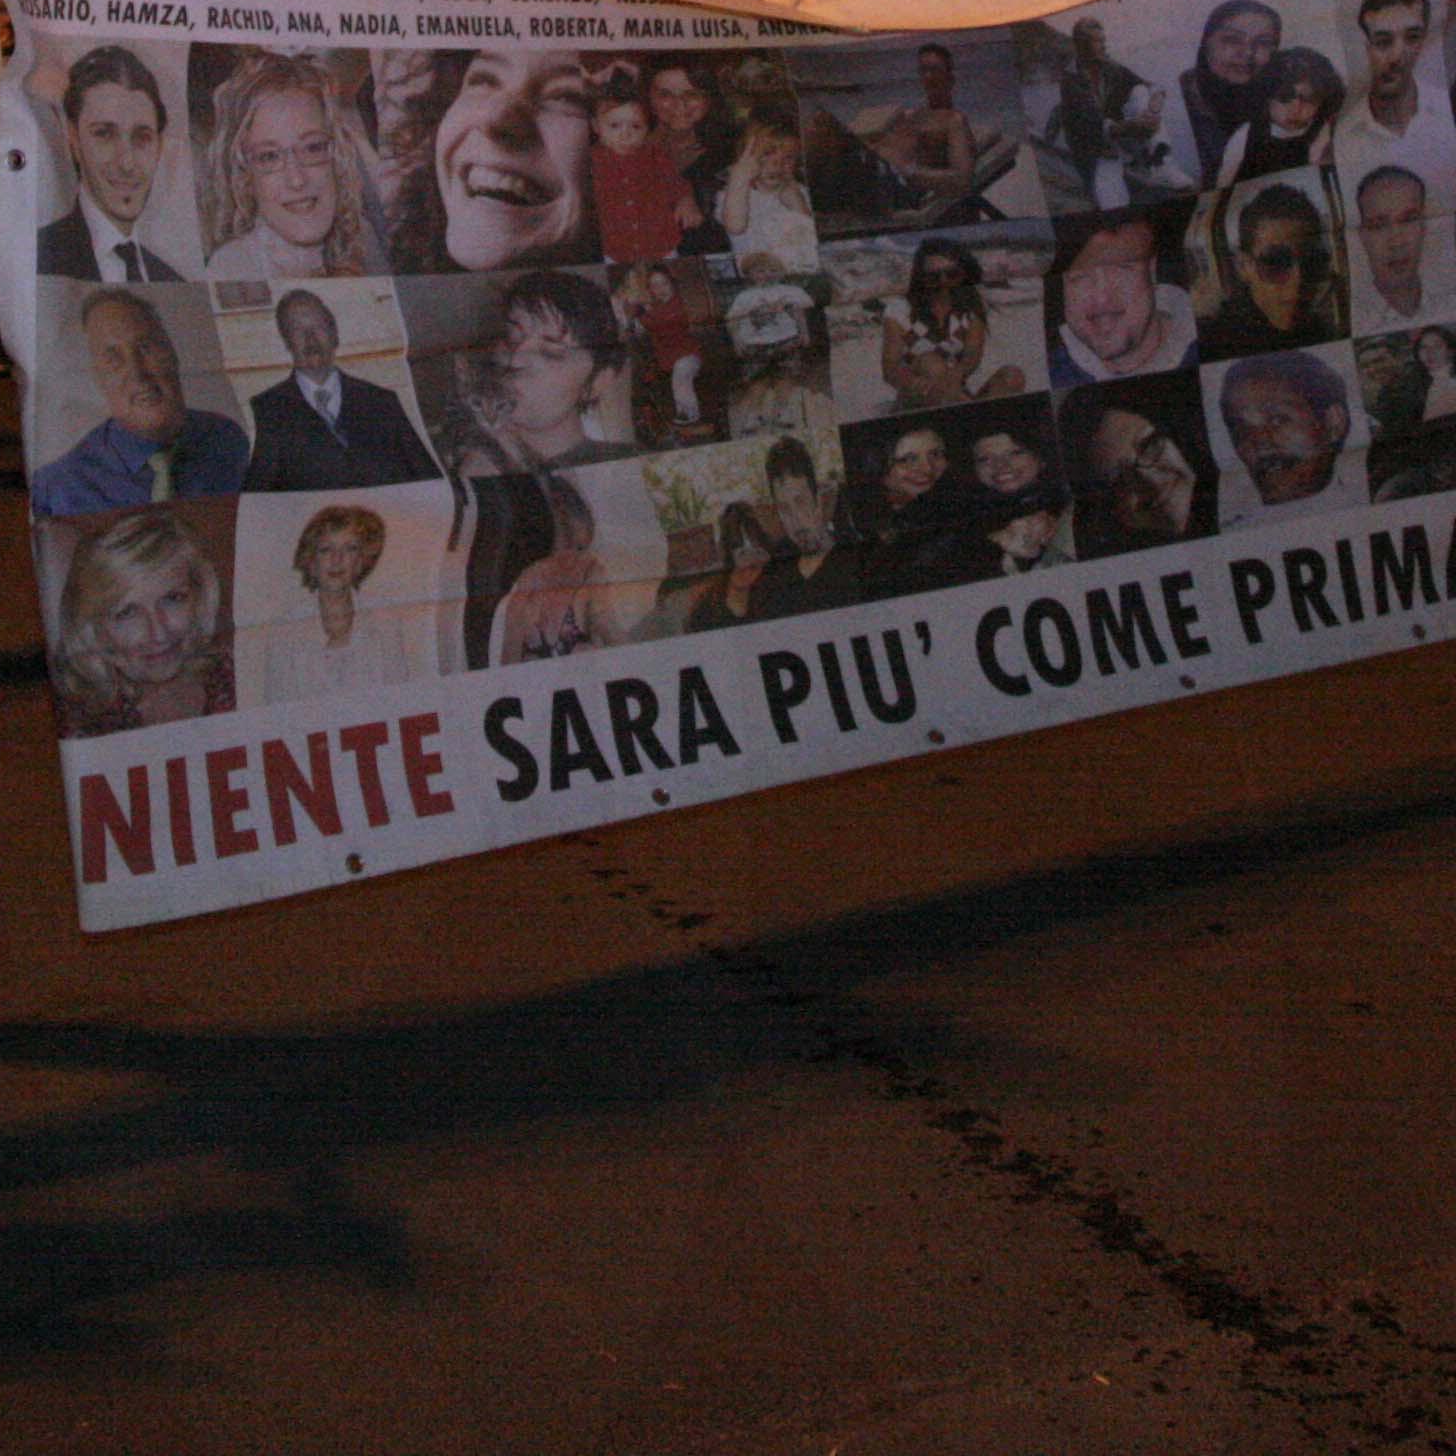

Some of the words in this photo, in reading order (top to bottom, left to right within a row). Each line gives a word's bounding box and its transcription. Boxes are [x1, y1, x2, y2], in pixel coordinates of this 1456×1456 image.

[107, 0, 196, 31] HAMZA,
[207, 6, 280, 35] RACHID,
[288, 11, 331, 37] ANA,
[340, 13, 407, 39] NADIA,
[416, 15, 520, 40] EMANUELA,
[530, 17, 615, 40] ROBERTA,
[624, 18, 684, 38] MARIA
[694, 18, 749, 40] LUISA,
[78, 711, 455, 885] NIENTE
[483, 665, 741, 803] SARA
[757, 620, 933, 745] PIU'
[975, 570, 1212, 697] COME
